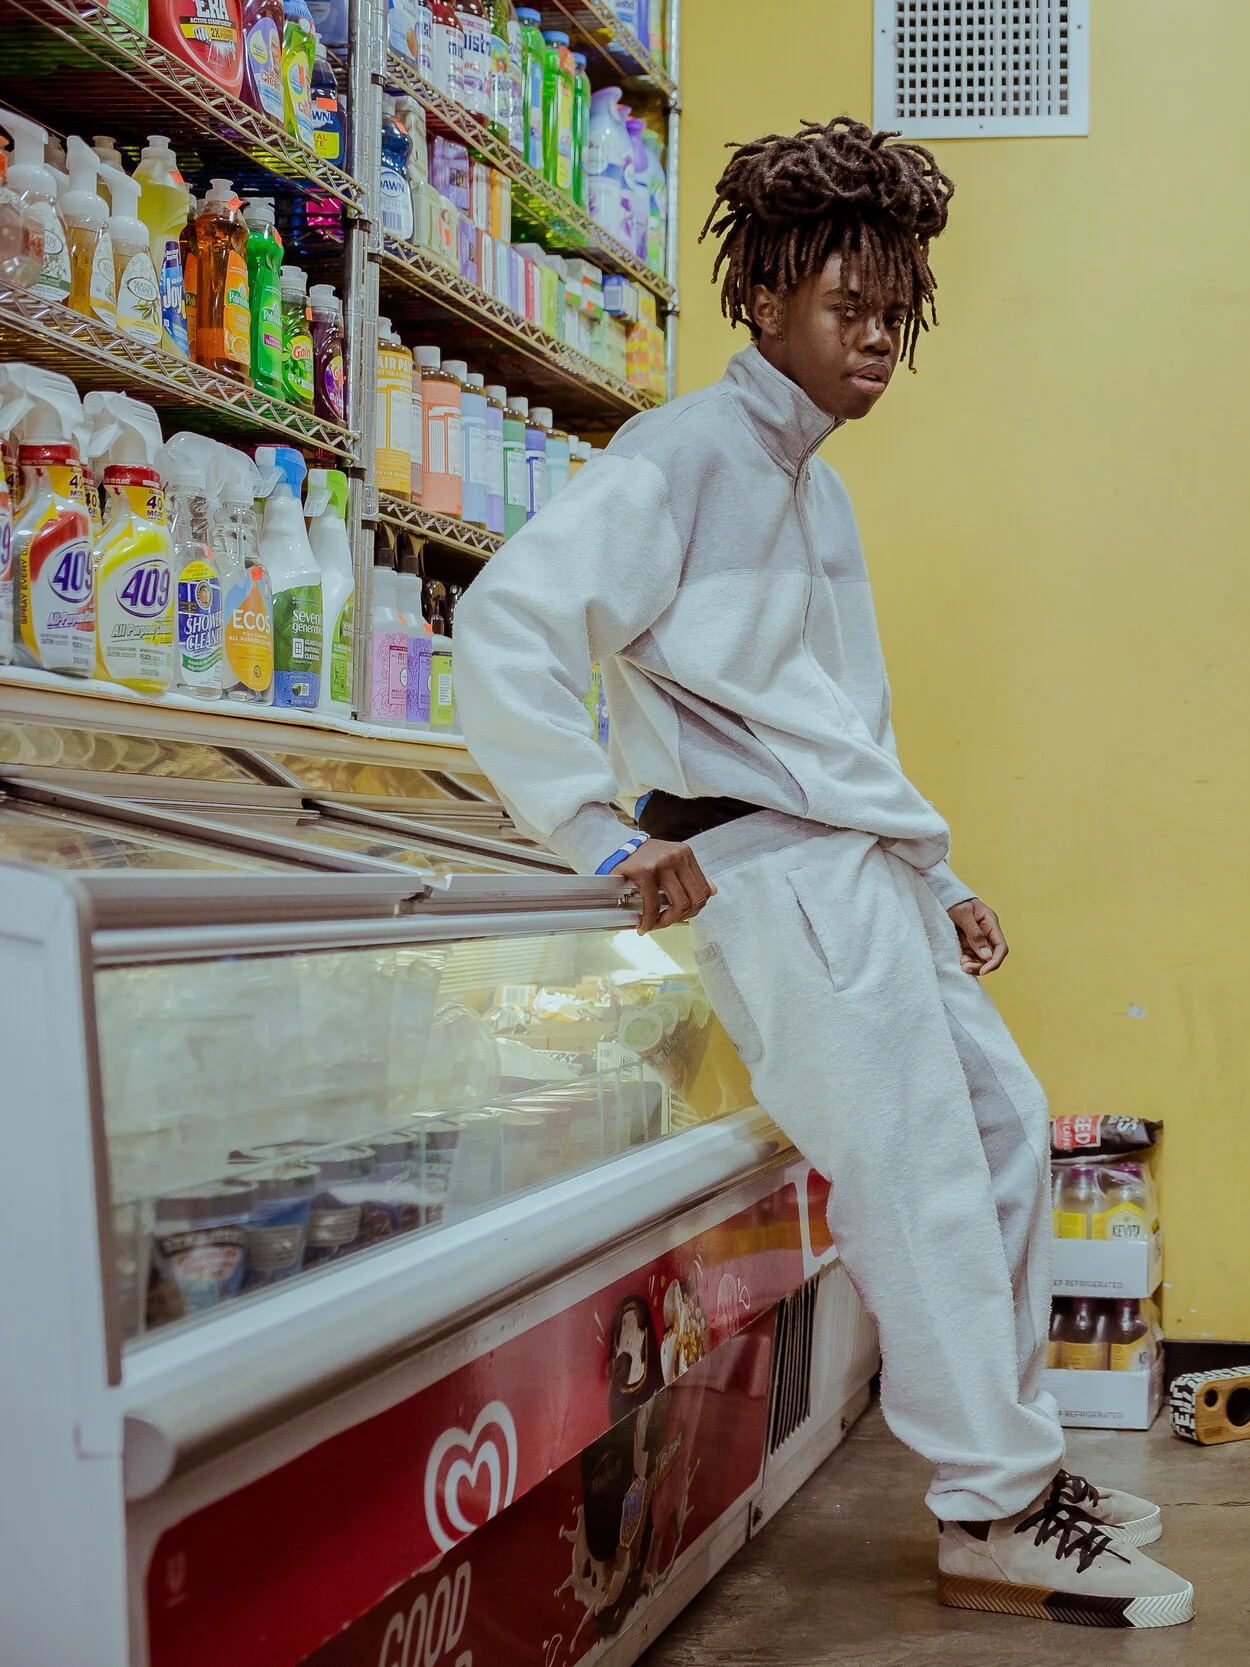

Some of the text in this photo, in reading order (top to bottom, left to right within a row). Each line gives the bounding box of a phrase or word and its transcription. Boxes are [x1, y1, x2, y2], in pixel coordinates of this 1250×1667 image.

[194, 0, 230, 20] ERA
[211, 27, 220, 38] 2X
[312, 110, 330, 121] WN
[381, 180, 405, 193] AWN
[293, 345, 310, 359] Gain
[377, 356, 396, 371] AIR
[146, 496, 163, 510] 40
[20, 562, 28, 590] EVERY
[52, 549, 93, 592] 409
[120, 568, 171, 606] 409
[20, 595, 28, 624] SPRAY
[111, 624, 126, 638] All
[184, 610, 221, 634] SHOWE
[232, 609, 271, 633] ECOS
[185, 628, 221, 652] CLEANE
[1065, 1280, 1124, 1289] REFRIGERATED
[379, 1560, 471, 1667] GOOD
